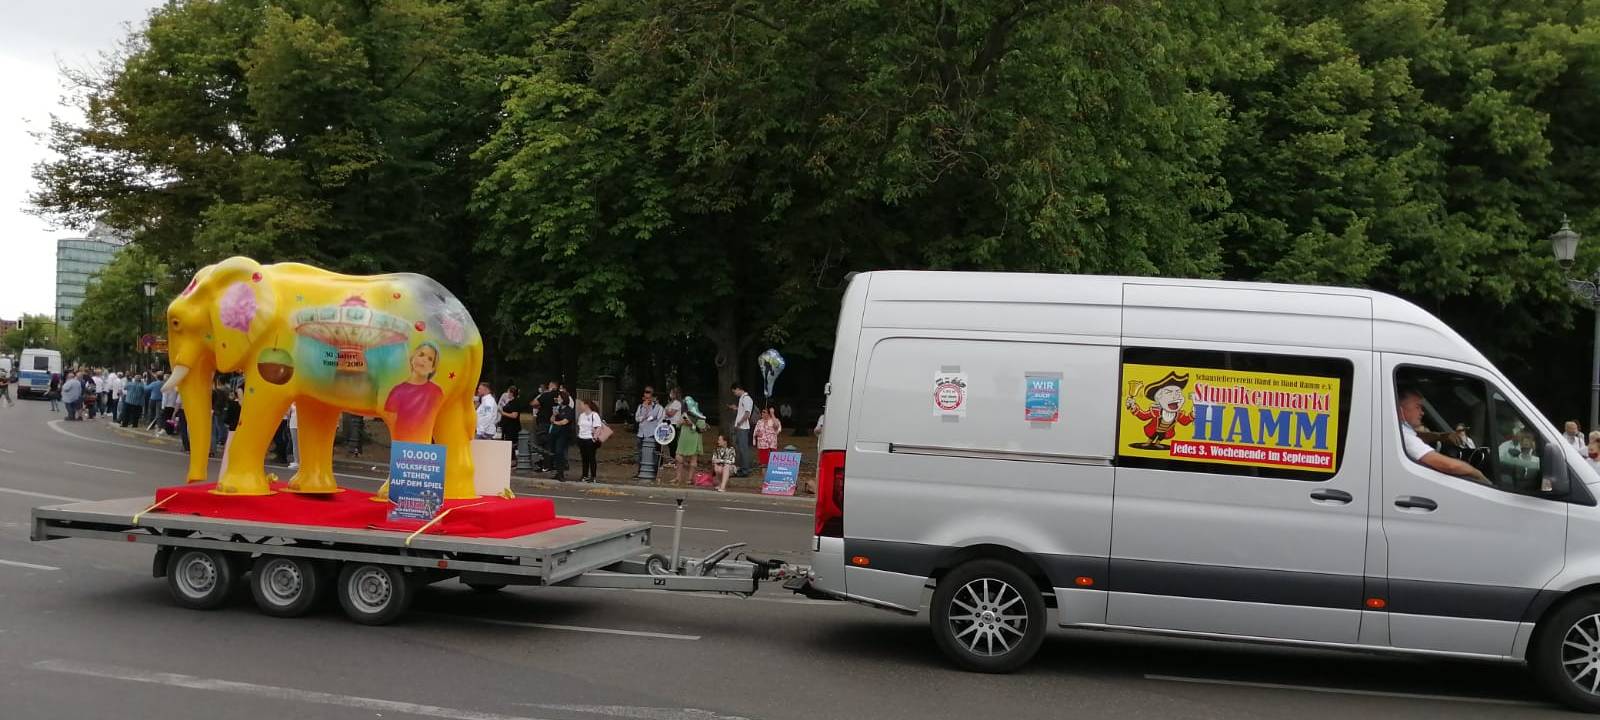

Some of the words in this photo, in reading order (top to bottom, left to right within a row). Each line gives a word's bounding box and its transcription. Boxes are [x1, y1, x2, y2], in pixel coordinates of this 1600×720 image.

[1032, 380, 1054, 390] WIR
[1194, 383, 1330, 411] Stunikenmarkt
[1192, 404, 1330, 450] HAMM
[402, 449, 438, 461] 10.000
[1198, 445, 1208, 456] 3.
[1210, 446, 1266, 460] Wochenende
[1282, 451, 1330, 466] September
[395, 461, 441, 473] VOLKSFESTE
[402, 471, 430, 480] STEHEN
[390, 478, 406, 486] AUF
[406, 480, 422, 488] DEM
[423, 481, 443, 490] SPIEL
